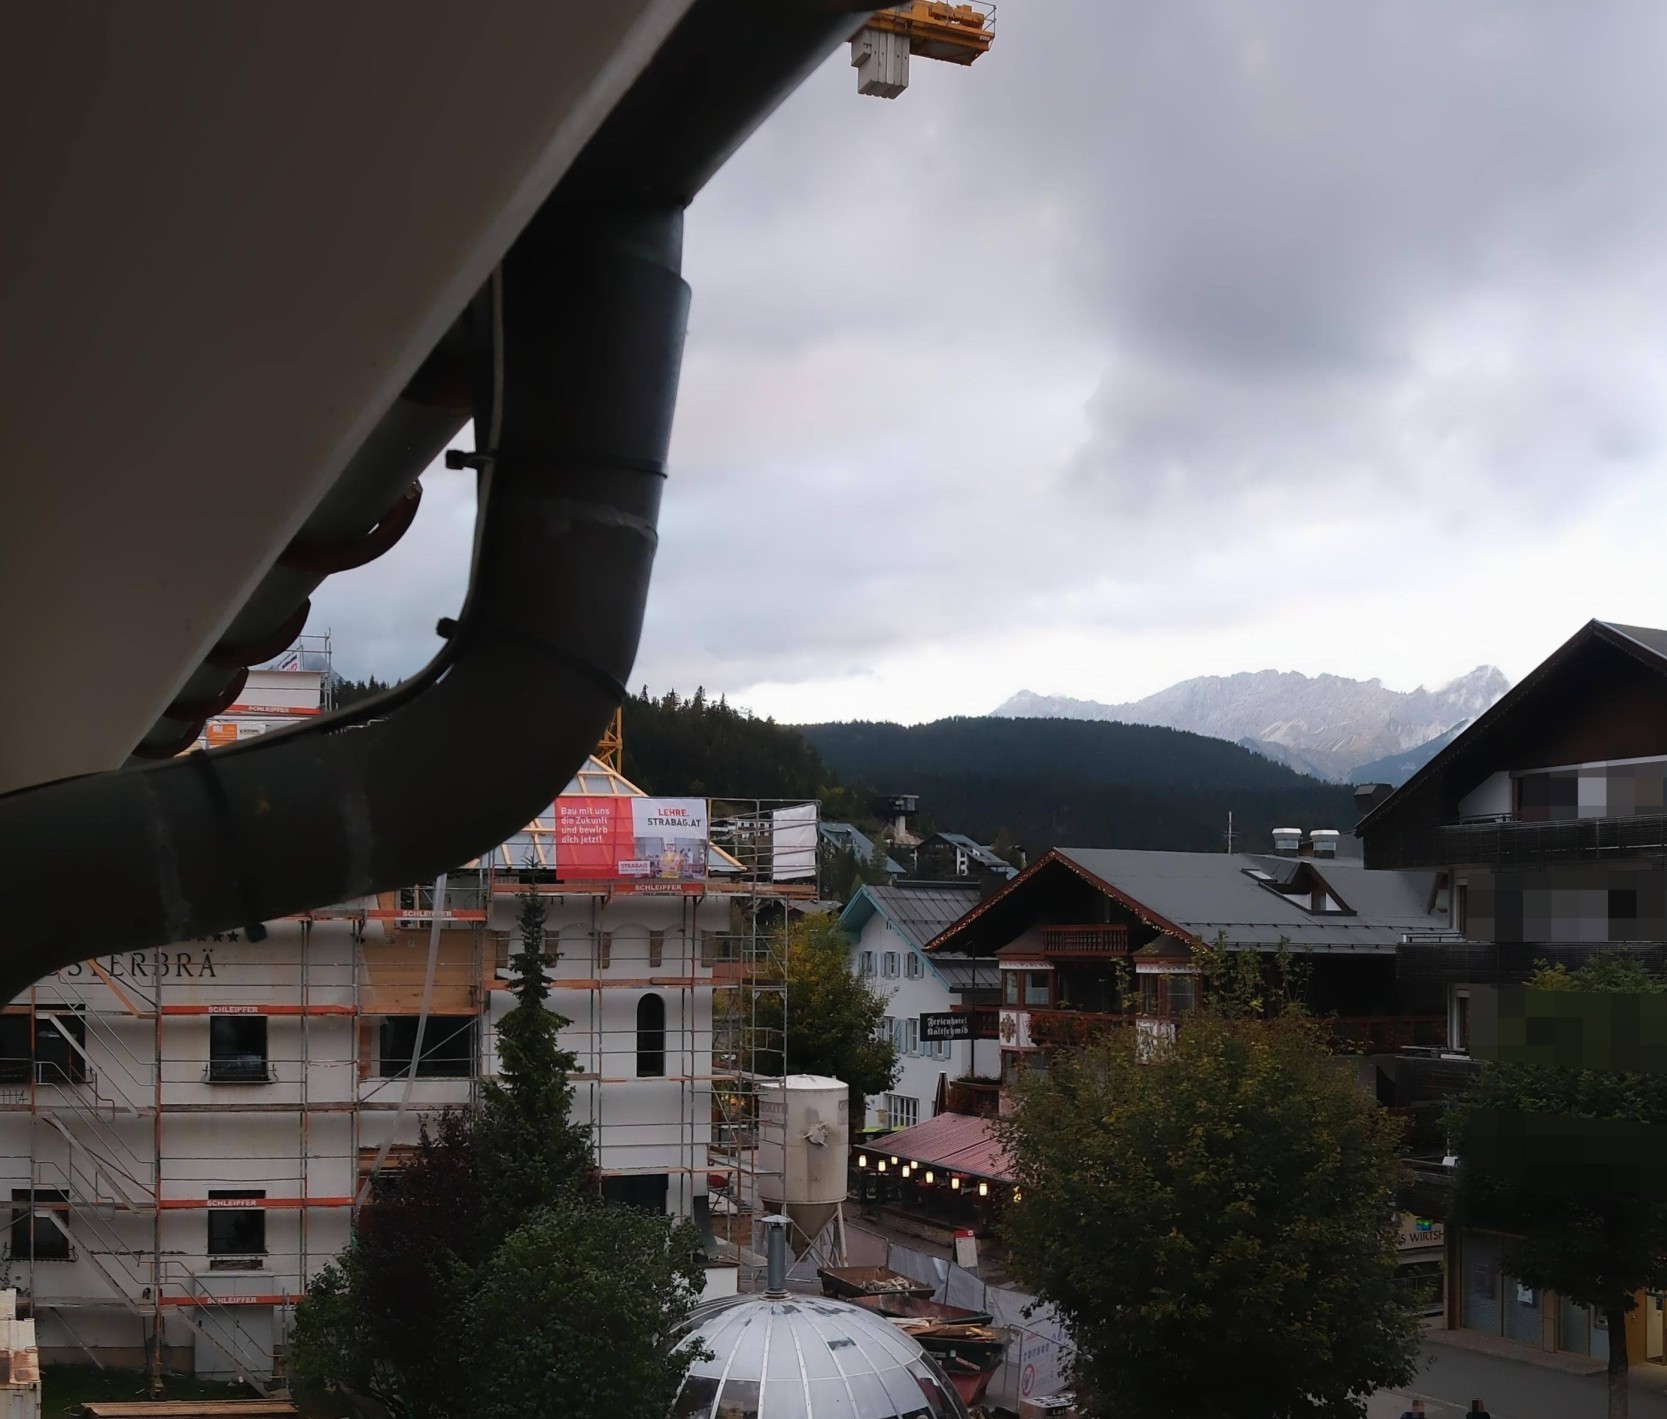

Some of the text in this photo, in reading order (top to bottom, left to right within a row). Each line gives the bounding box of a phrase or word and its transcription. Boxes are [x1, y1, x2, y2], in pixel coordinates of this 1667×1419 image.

[561, 807, 577, 815] Bau
[579, 807, 593, 815] mit
[658, 808, 690, 817] LEHRE.
[561, 817, 574, 825] die
[647, 818, 702, 827] STRABAG.AT
[561, 826, 608, 834] und bewirb
[561, 835, 602, 845] dich jetzt!
